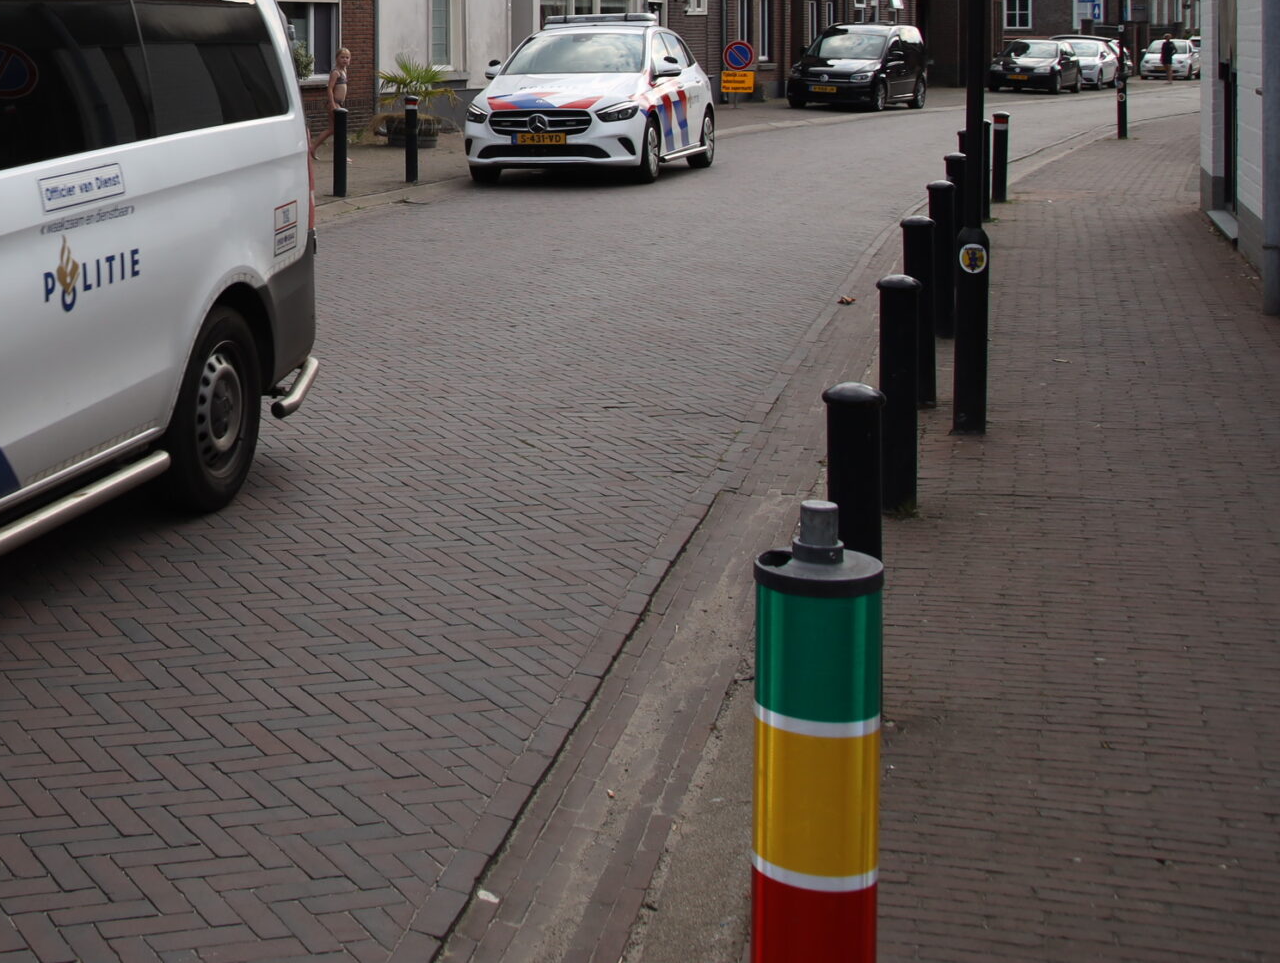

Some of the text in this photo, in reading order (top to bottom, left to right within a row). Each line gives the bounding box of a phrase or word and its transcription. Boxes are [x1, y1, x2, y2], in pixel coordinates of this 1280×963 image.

[520, 134, 561, 143] S-431-VD
[45, 174, 121, 201] Officier van Dienst
[43, 248, 140, 312] POLITIE
